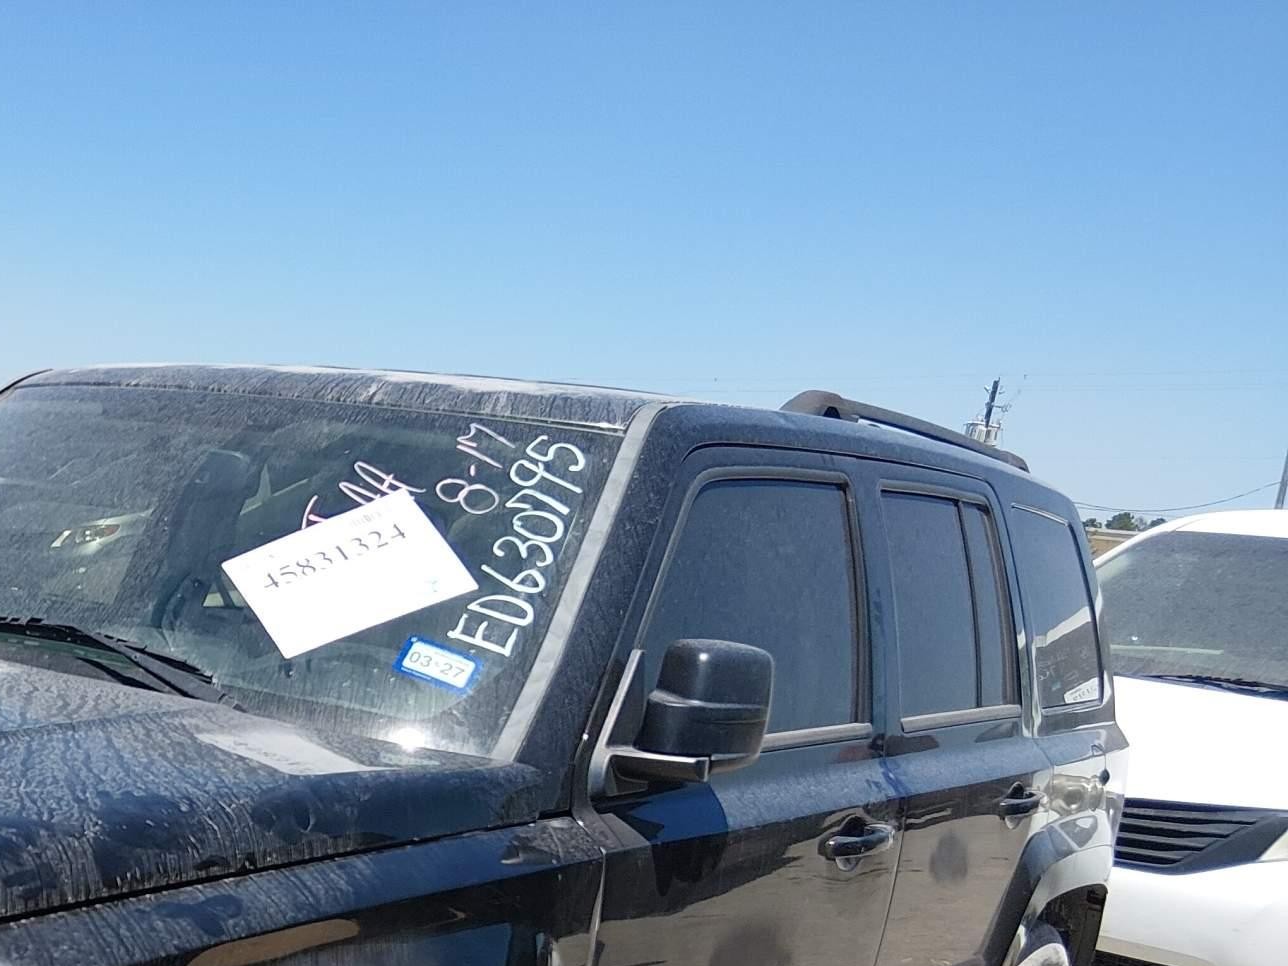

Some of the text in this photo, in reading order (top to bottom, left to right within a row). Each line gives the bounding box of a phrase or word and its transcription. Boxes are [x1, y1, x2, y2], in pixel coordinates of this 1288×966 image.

[435, 423, 516, 514] 8-17
[263, 523, 406, 589] 45831324
[447, 434, 586, 657] ED630795
